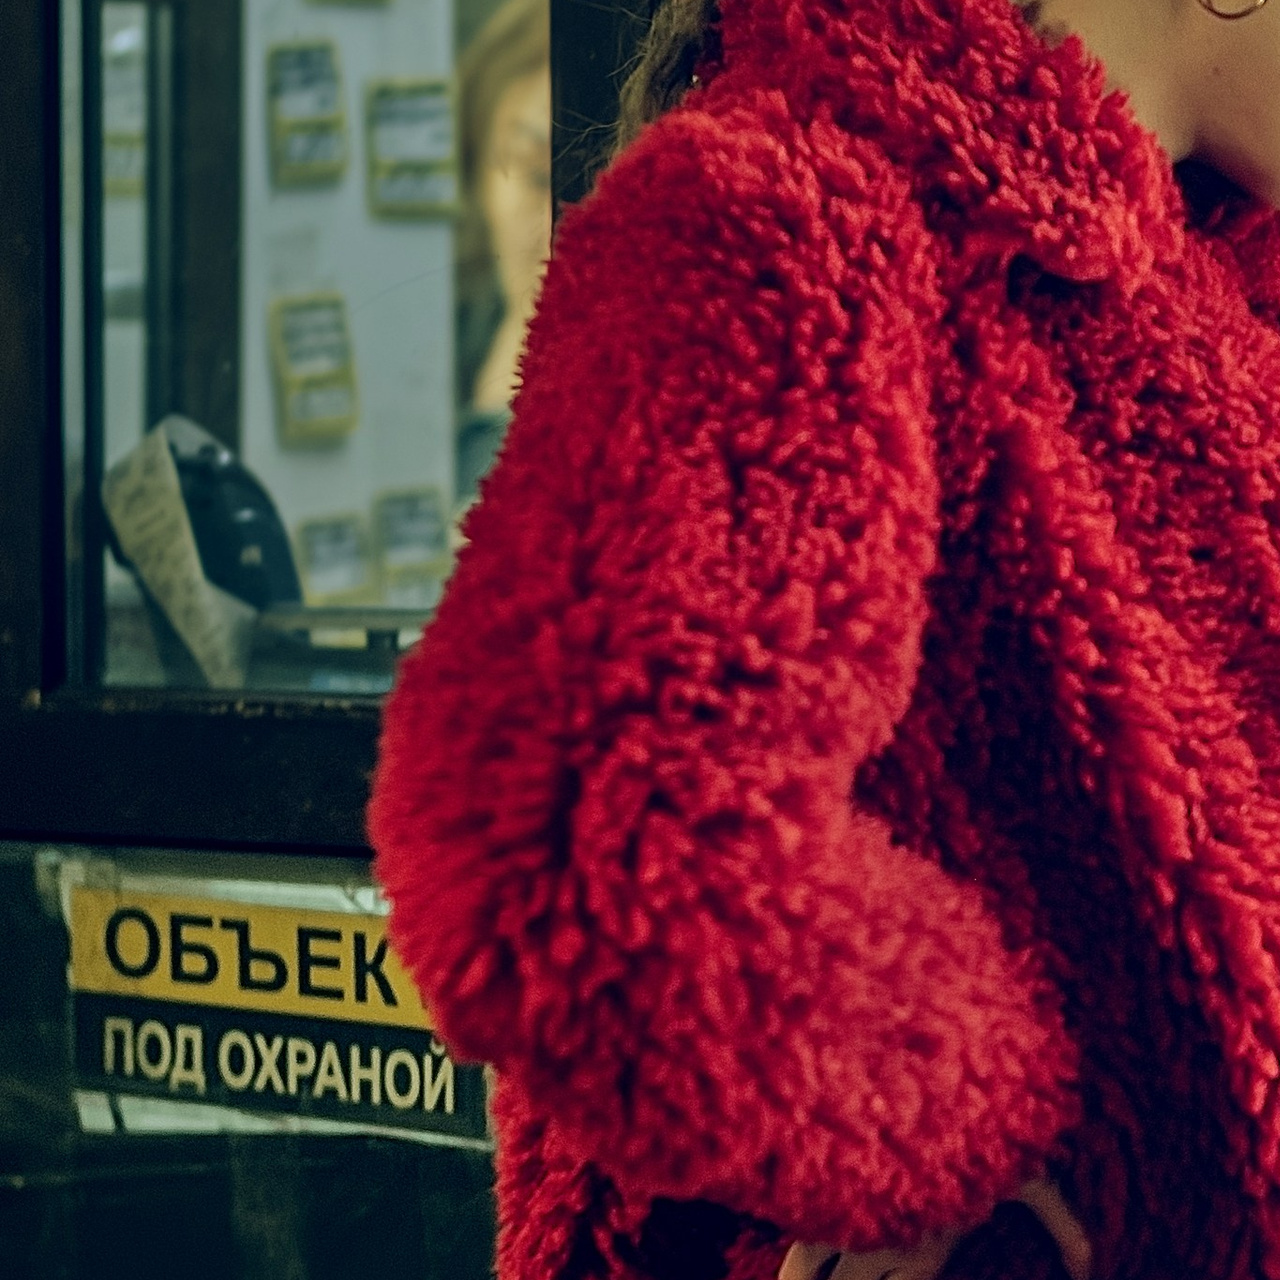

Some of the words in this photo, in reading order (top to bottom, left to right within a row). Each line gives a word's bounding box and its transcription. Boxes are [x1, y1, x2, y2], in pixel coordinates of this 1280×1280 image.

[104, 907, 399, 1008] ОБЪЕК
[102, 1016, 206, 1094] ПОД
[217, 1029, 456, 1115] ОХРАНОЙ
